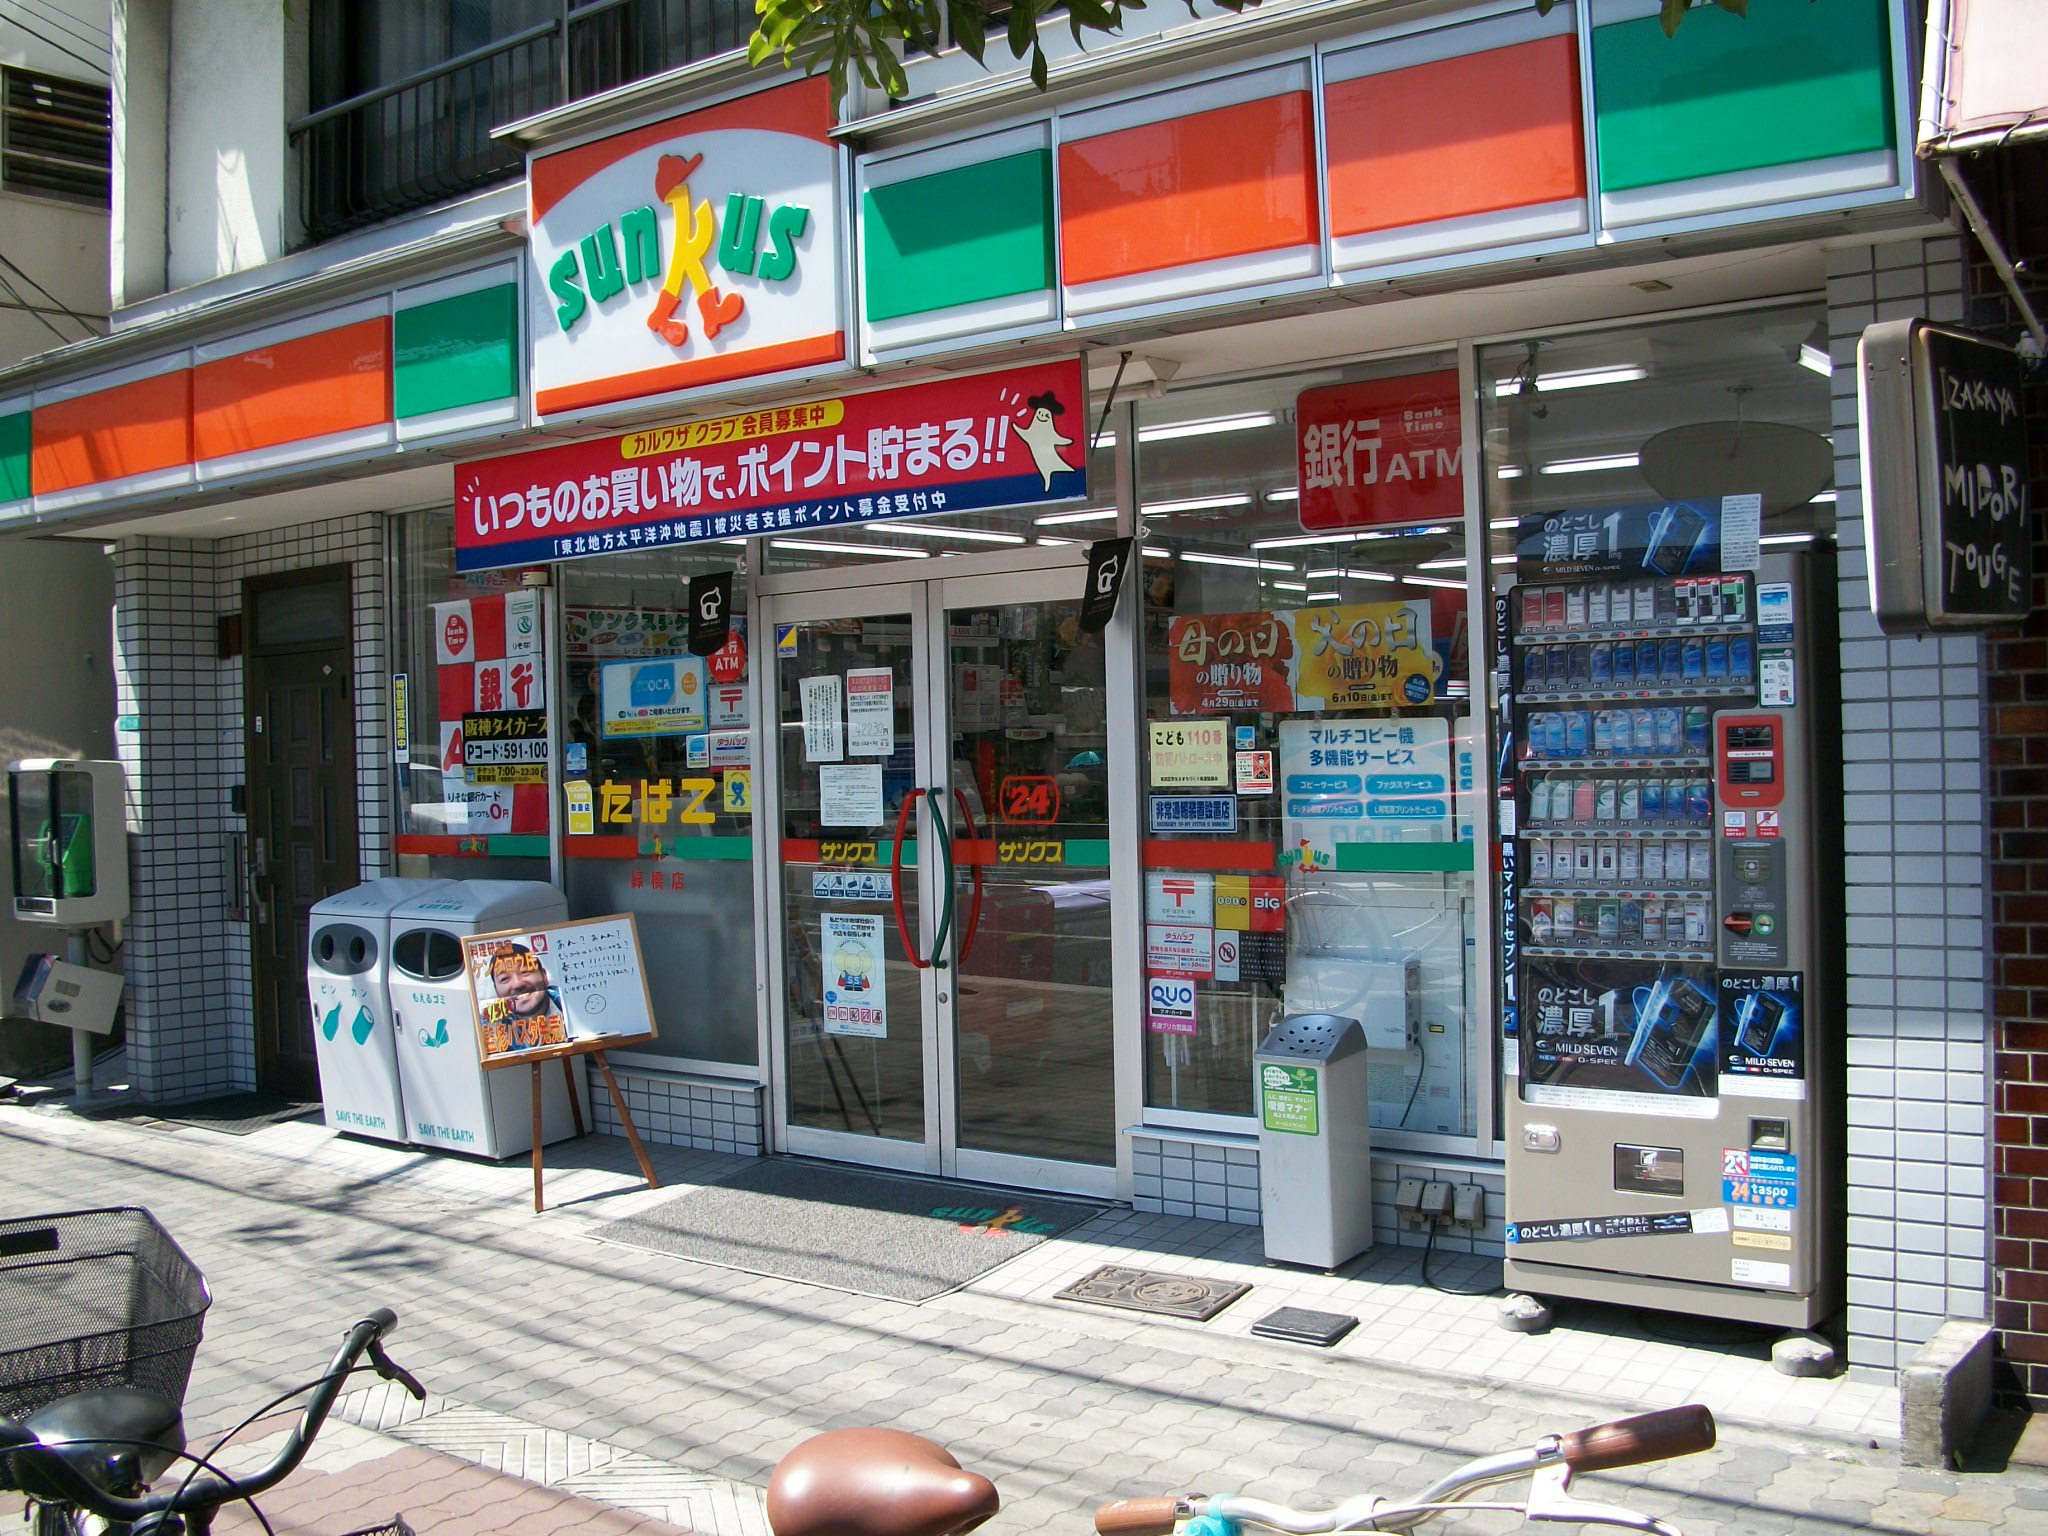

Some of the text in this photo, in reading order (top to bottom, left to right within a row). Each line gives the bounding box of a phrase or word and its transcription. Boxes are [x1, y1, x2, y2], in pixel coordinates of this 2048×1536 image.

[549, 153, 810, 347] sunkus
[1939, 367, 2018, 426] IZAKAYA
[1403, 407, 1443, 421] Bank
[633, 407, 827, 455] カルワザ クラブ会員募集中
[1404, 421, 1444, 433] Time
[1303, 419, 1463, 490] 銀行 ATM
[1944, 463, 2026, 527] MIDORI
[1544, 514, 1600, 532] のどごし
[1543, 532, 1600, 562] 濃厚
[1555, 566, 1572, 574] MILD
[1573, 565, 1594, 573] SEVEN
[1946, 540, 2021, 602] TOUGE
[1311, 608, 1418, 656] 父の日
[1179, 620, 1278, 666] 母の日
[715, 657, 738, 671] ATM
[1328, 655, 1398, 680] の贈り物
[1196, 662, 1262, 686] の贈り物
[479, 662, 534, 711] 銀行
[1202, 698, 1258, 708] 4月29日(金)まで
[465, 716, 547, 737] 阪神タイガース
[1309, 727, 1414, 745] マルチコピー機
[1156, 730, 1222, 746] こども110番
[1310, 749, 1416, 767] 多機能サービス
[601, 778, 715, 824] たばこ
[1008, 784, 1050, 816] 24
[820, 842, 876, 862] サンクス
[999, 842, 1062, 863] サンクス
[1217, 896, 1247, 906] toto
[847, 976, 860, 984] SS
[413, 992, 446, 1005] もえるゴミ
[1151, 985, 1192, 1007] QUO
[1538, 987, 1596, 1006] のどごし
[1536, 1005, 1595, 1038] 濃厚
[1555, 1043, 1618, 1056] MILD SEVEN
[1578, 1057, 1617, 1066] D-SPEC
[1745, 1056, 1794, 1068] MILD SEVEN
[336, 1110, 385, 1128] SAVE THE EARTH
[419, 1123, 475, 1142] SAVE THE EARTH
[1724, 1155, 1747, 1174] 20
[1731, 1181, 1788, 1198] 24 taspo
[1594, 1225, 1602, 1233] &
[1606, 1225, 1650, 1235] D-SPEC
